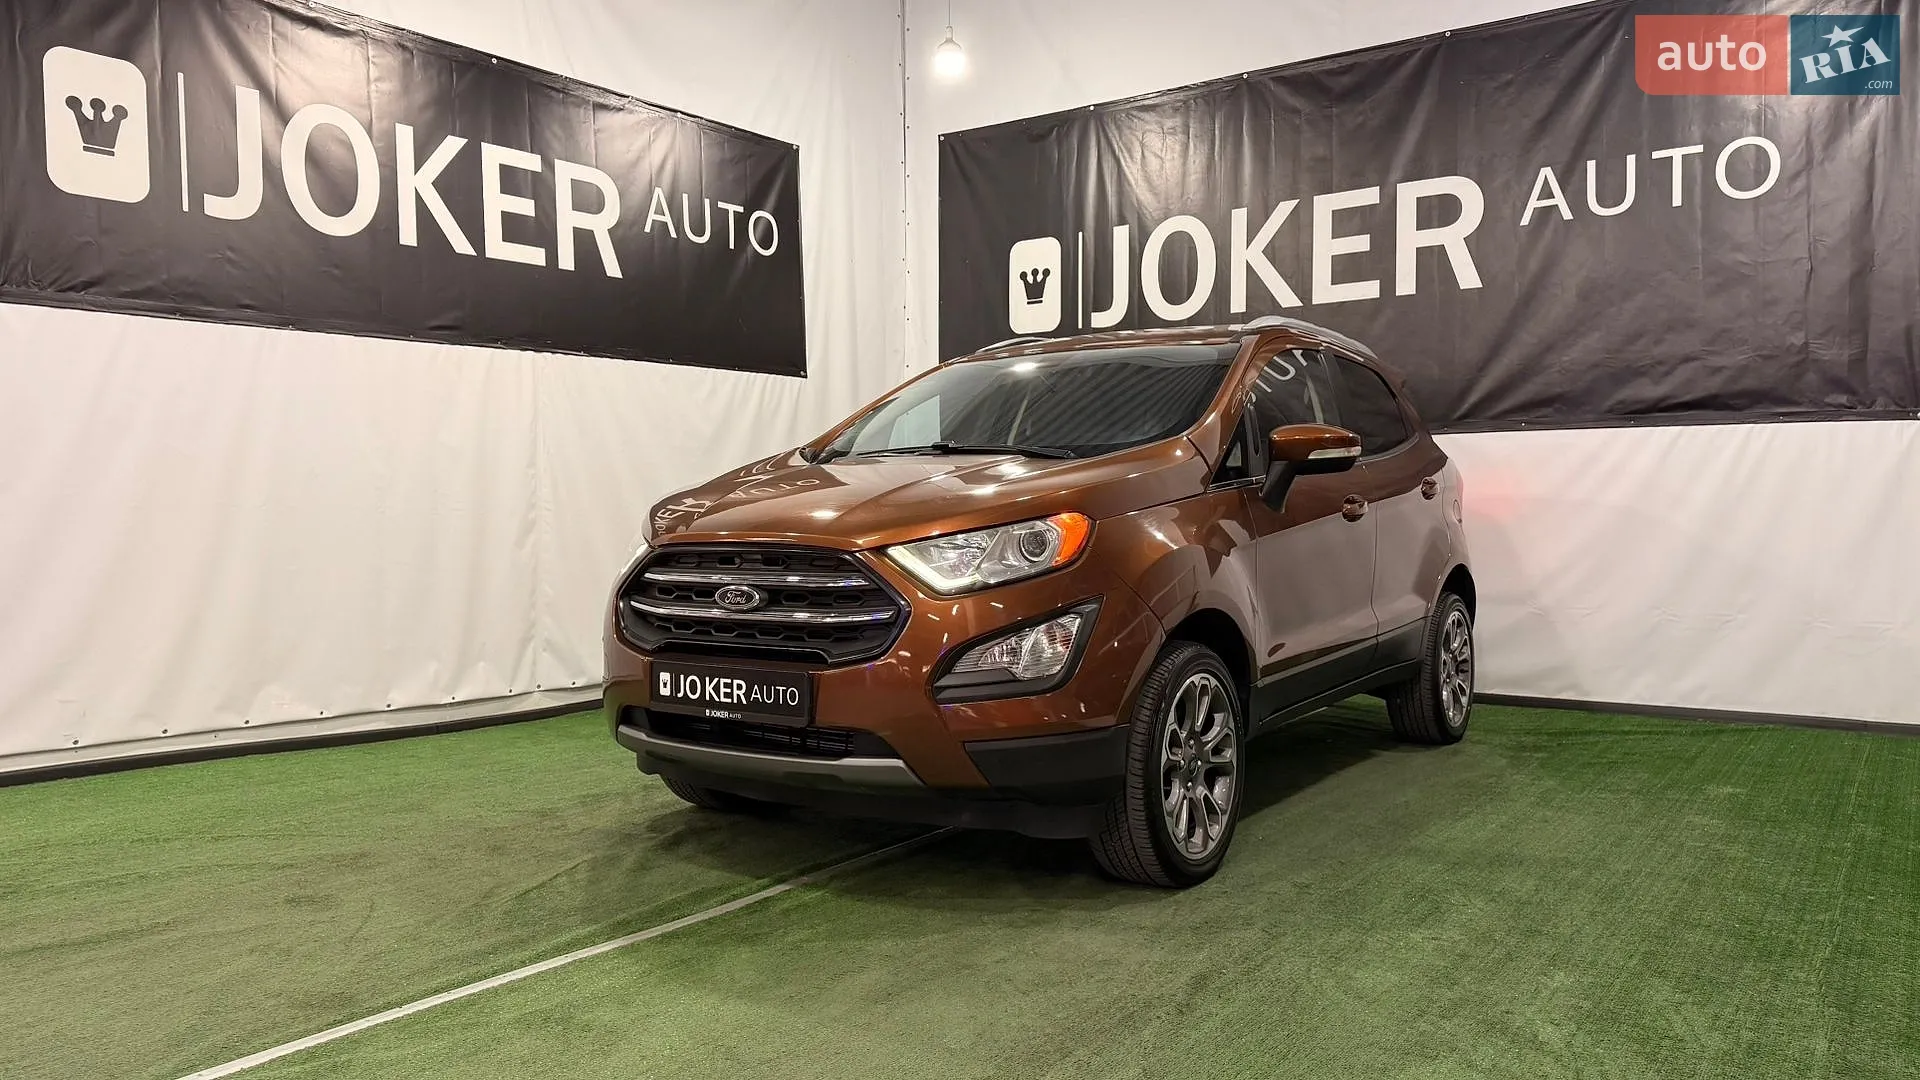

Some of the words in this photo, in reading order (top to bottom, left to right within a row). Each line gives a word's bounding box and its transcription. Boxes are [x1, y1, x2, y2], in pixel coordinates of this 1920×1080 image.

[203, 85, 623, 279] JOKER
[643, 186, 779, 257] AUTO
[1090, 174, 1485, 329] JOKER
[1519, 136, 1781, 226] AUTO
[725, 590, 747, 603] Ford
[677, 674, 747, 705] JOKER
[750, 684, 799, 705] AUTO
[710, 710, 729, 719] JOKER
